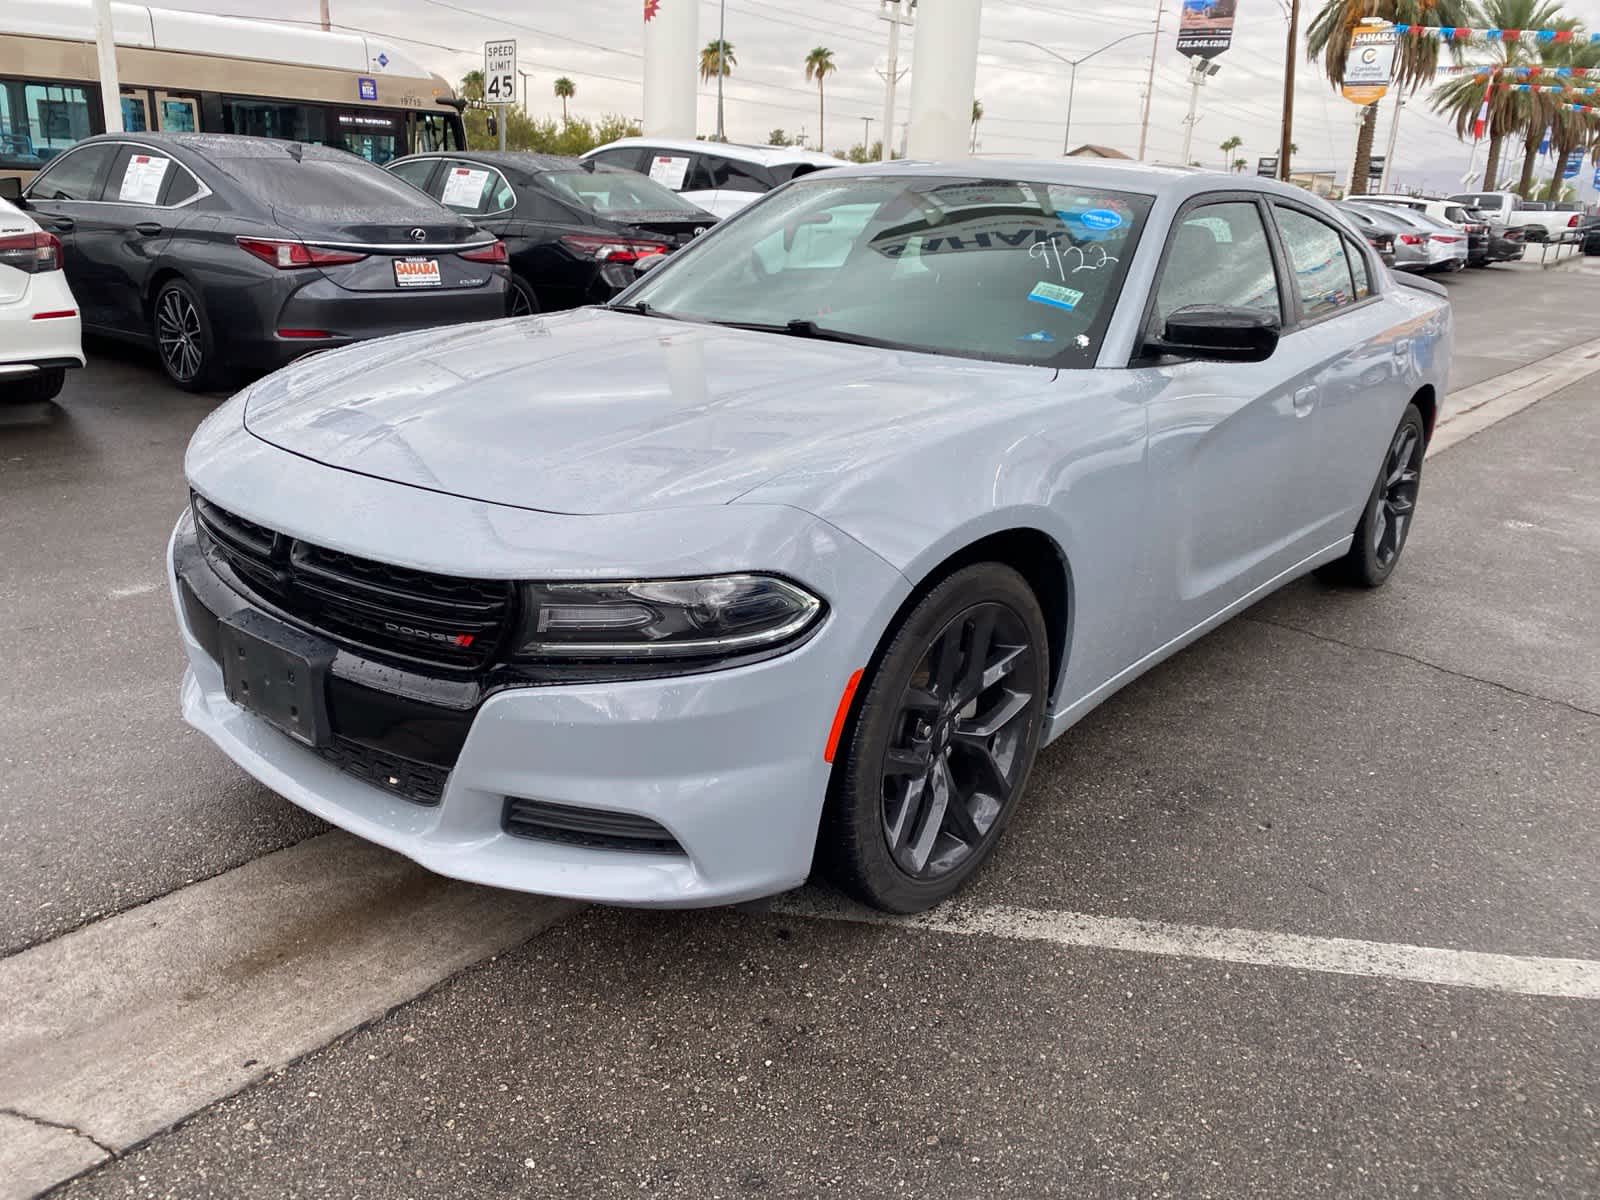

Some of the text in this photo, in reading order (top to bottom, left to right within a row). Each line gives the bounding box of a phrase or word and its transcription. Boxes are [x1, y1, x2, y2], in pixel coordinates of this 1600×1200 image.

[1355, 32, 1396, 43] SAHARA
[488, 46, 513, 57] SPEED
[490, 60, 511, 71] LIMIT
[488, 75, 513, 98] 45
[1029, 237, 1119, 281] 9/22
[397, 263, 437, 274] SAHARA
[385, 622, 458, 643] DODGE
